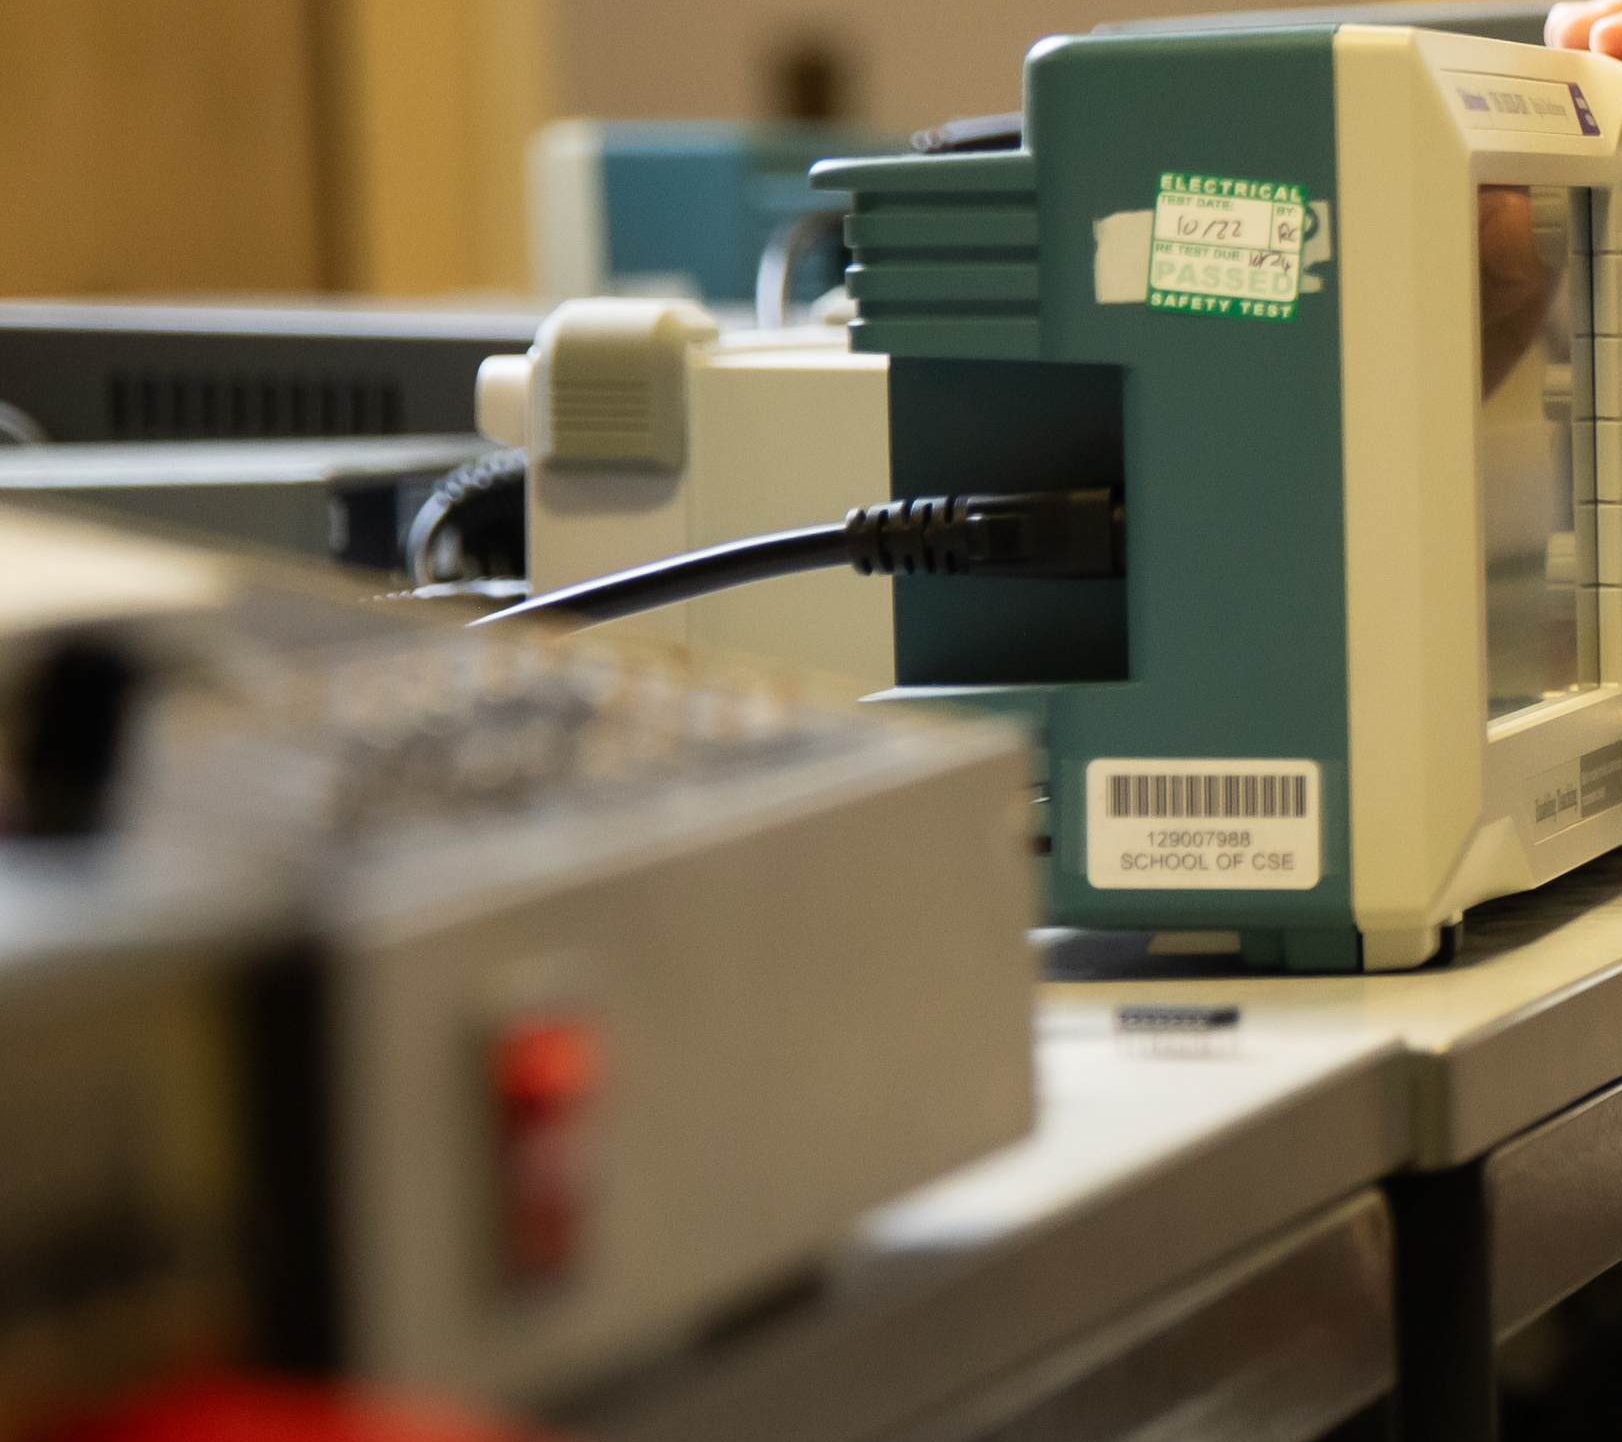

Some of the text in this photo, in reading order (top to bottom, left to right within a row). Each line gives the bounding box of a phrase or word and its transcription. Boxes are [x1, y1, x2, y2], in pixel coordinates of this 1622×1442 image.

[1160, 173, 1302, 202] ELECTRICAL
[1160, 195, 1192, 207] TEST
[1155, 243, 1173, 254] RE
[1178, 245, 1210, 256] TEST
[1153, 260, 1294, 296] PASSED
[1151, 292, 1294, 319] SAFETY TEST
[1147, 830, 1252, 848] 129007988
[1120, 852, 1295, 871] SCHOOL OF CSE
